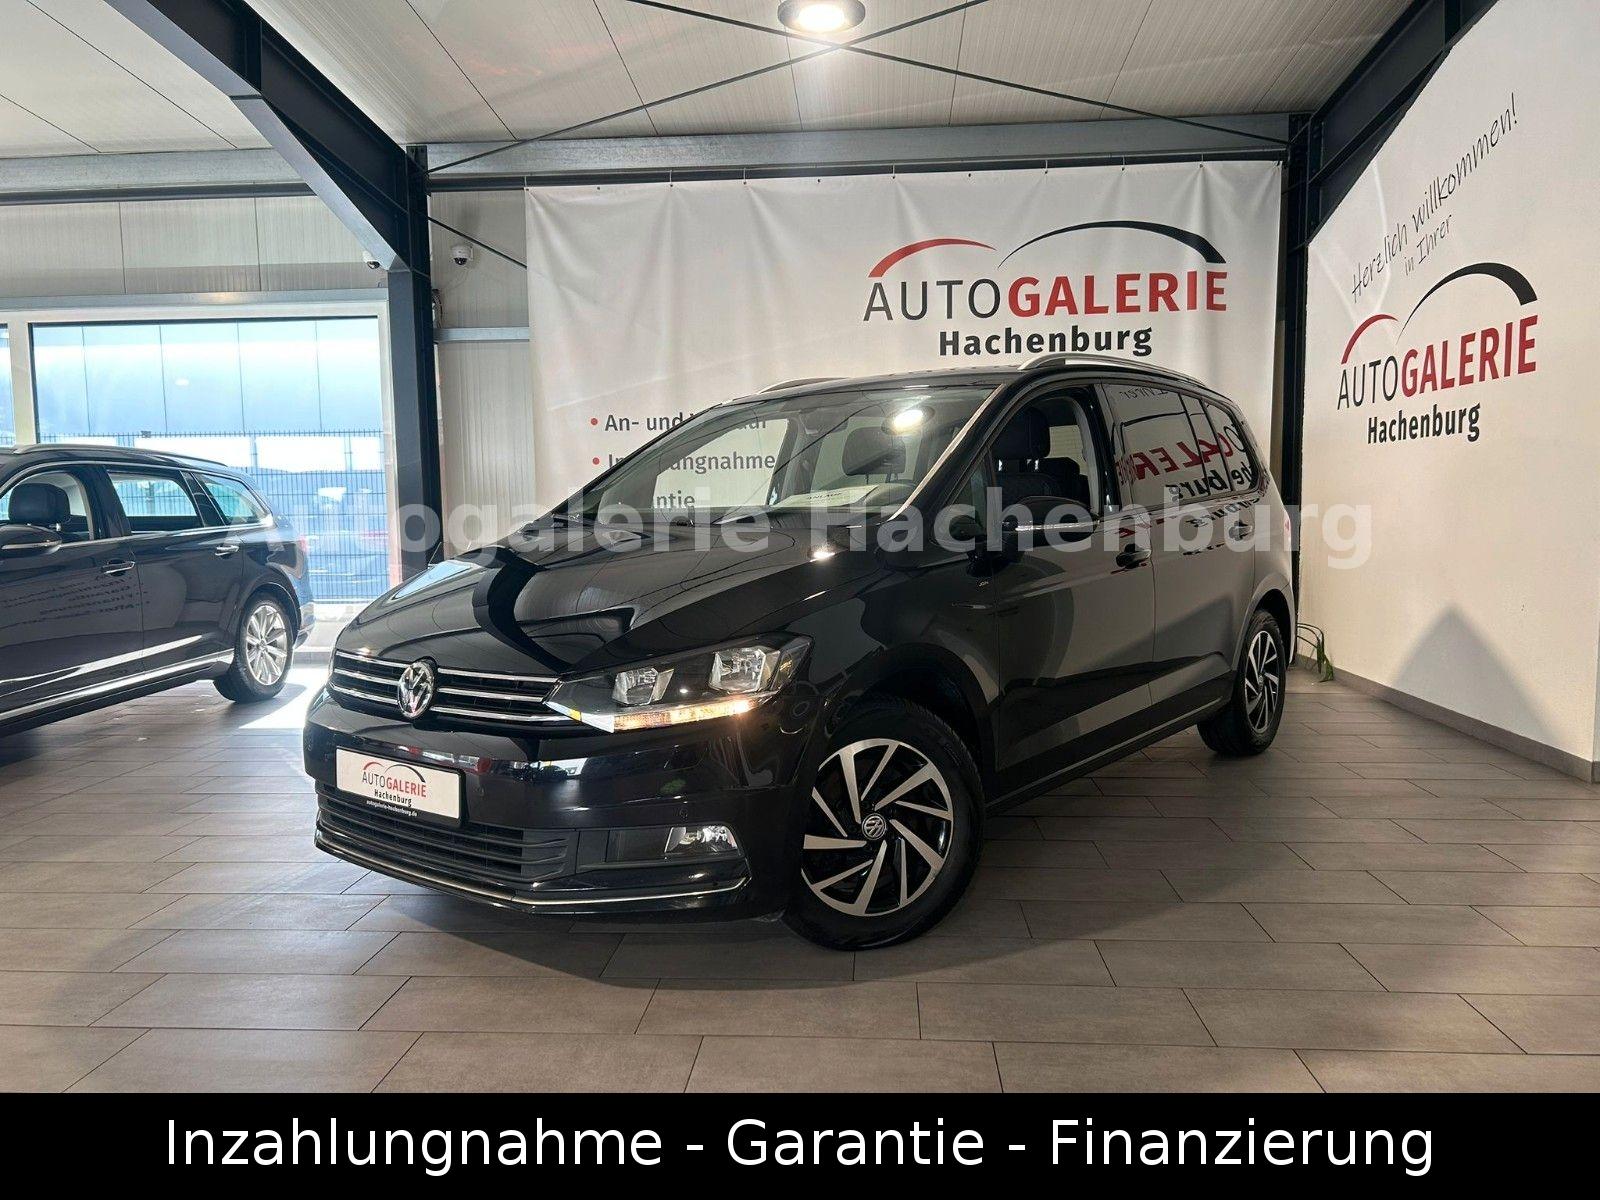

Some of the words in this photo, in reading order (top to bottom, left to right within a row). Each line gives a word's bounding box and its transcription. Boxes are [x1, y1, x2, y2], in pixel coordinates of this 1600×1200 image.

[1351, 222, 1408, 304] Herzlich
[1411, 92, 1518, 233] willkommen!
[1404, 256, 1415, 276] in
[1416, 214, 1453, 264] Ihrer
[862, 270, 1228, 322] AUTOGALERIE
[939, 325, 1152, 357] Hachenburg
[1336, 314, 1539, 410] AUTOGALERIE
[604, 414, 640, 432] An-
[646, 411, 683, 431] und
[1367, 402, 1481, 444] Hachenburg
[361, 770, 428, 799] AUTOGALERIE
[374, 788, 413, 808] Hachenburg
